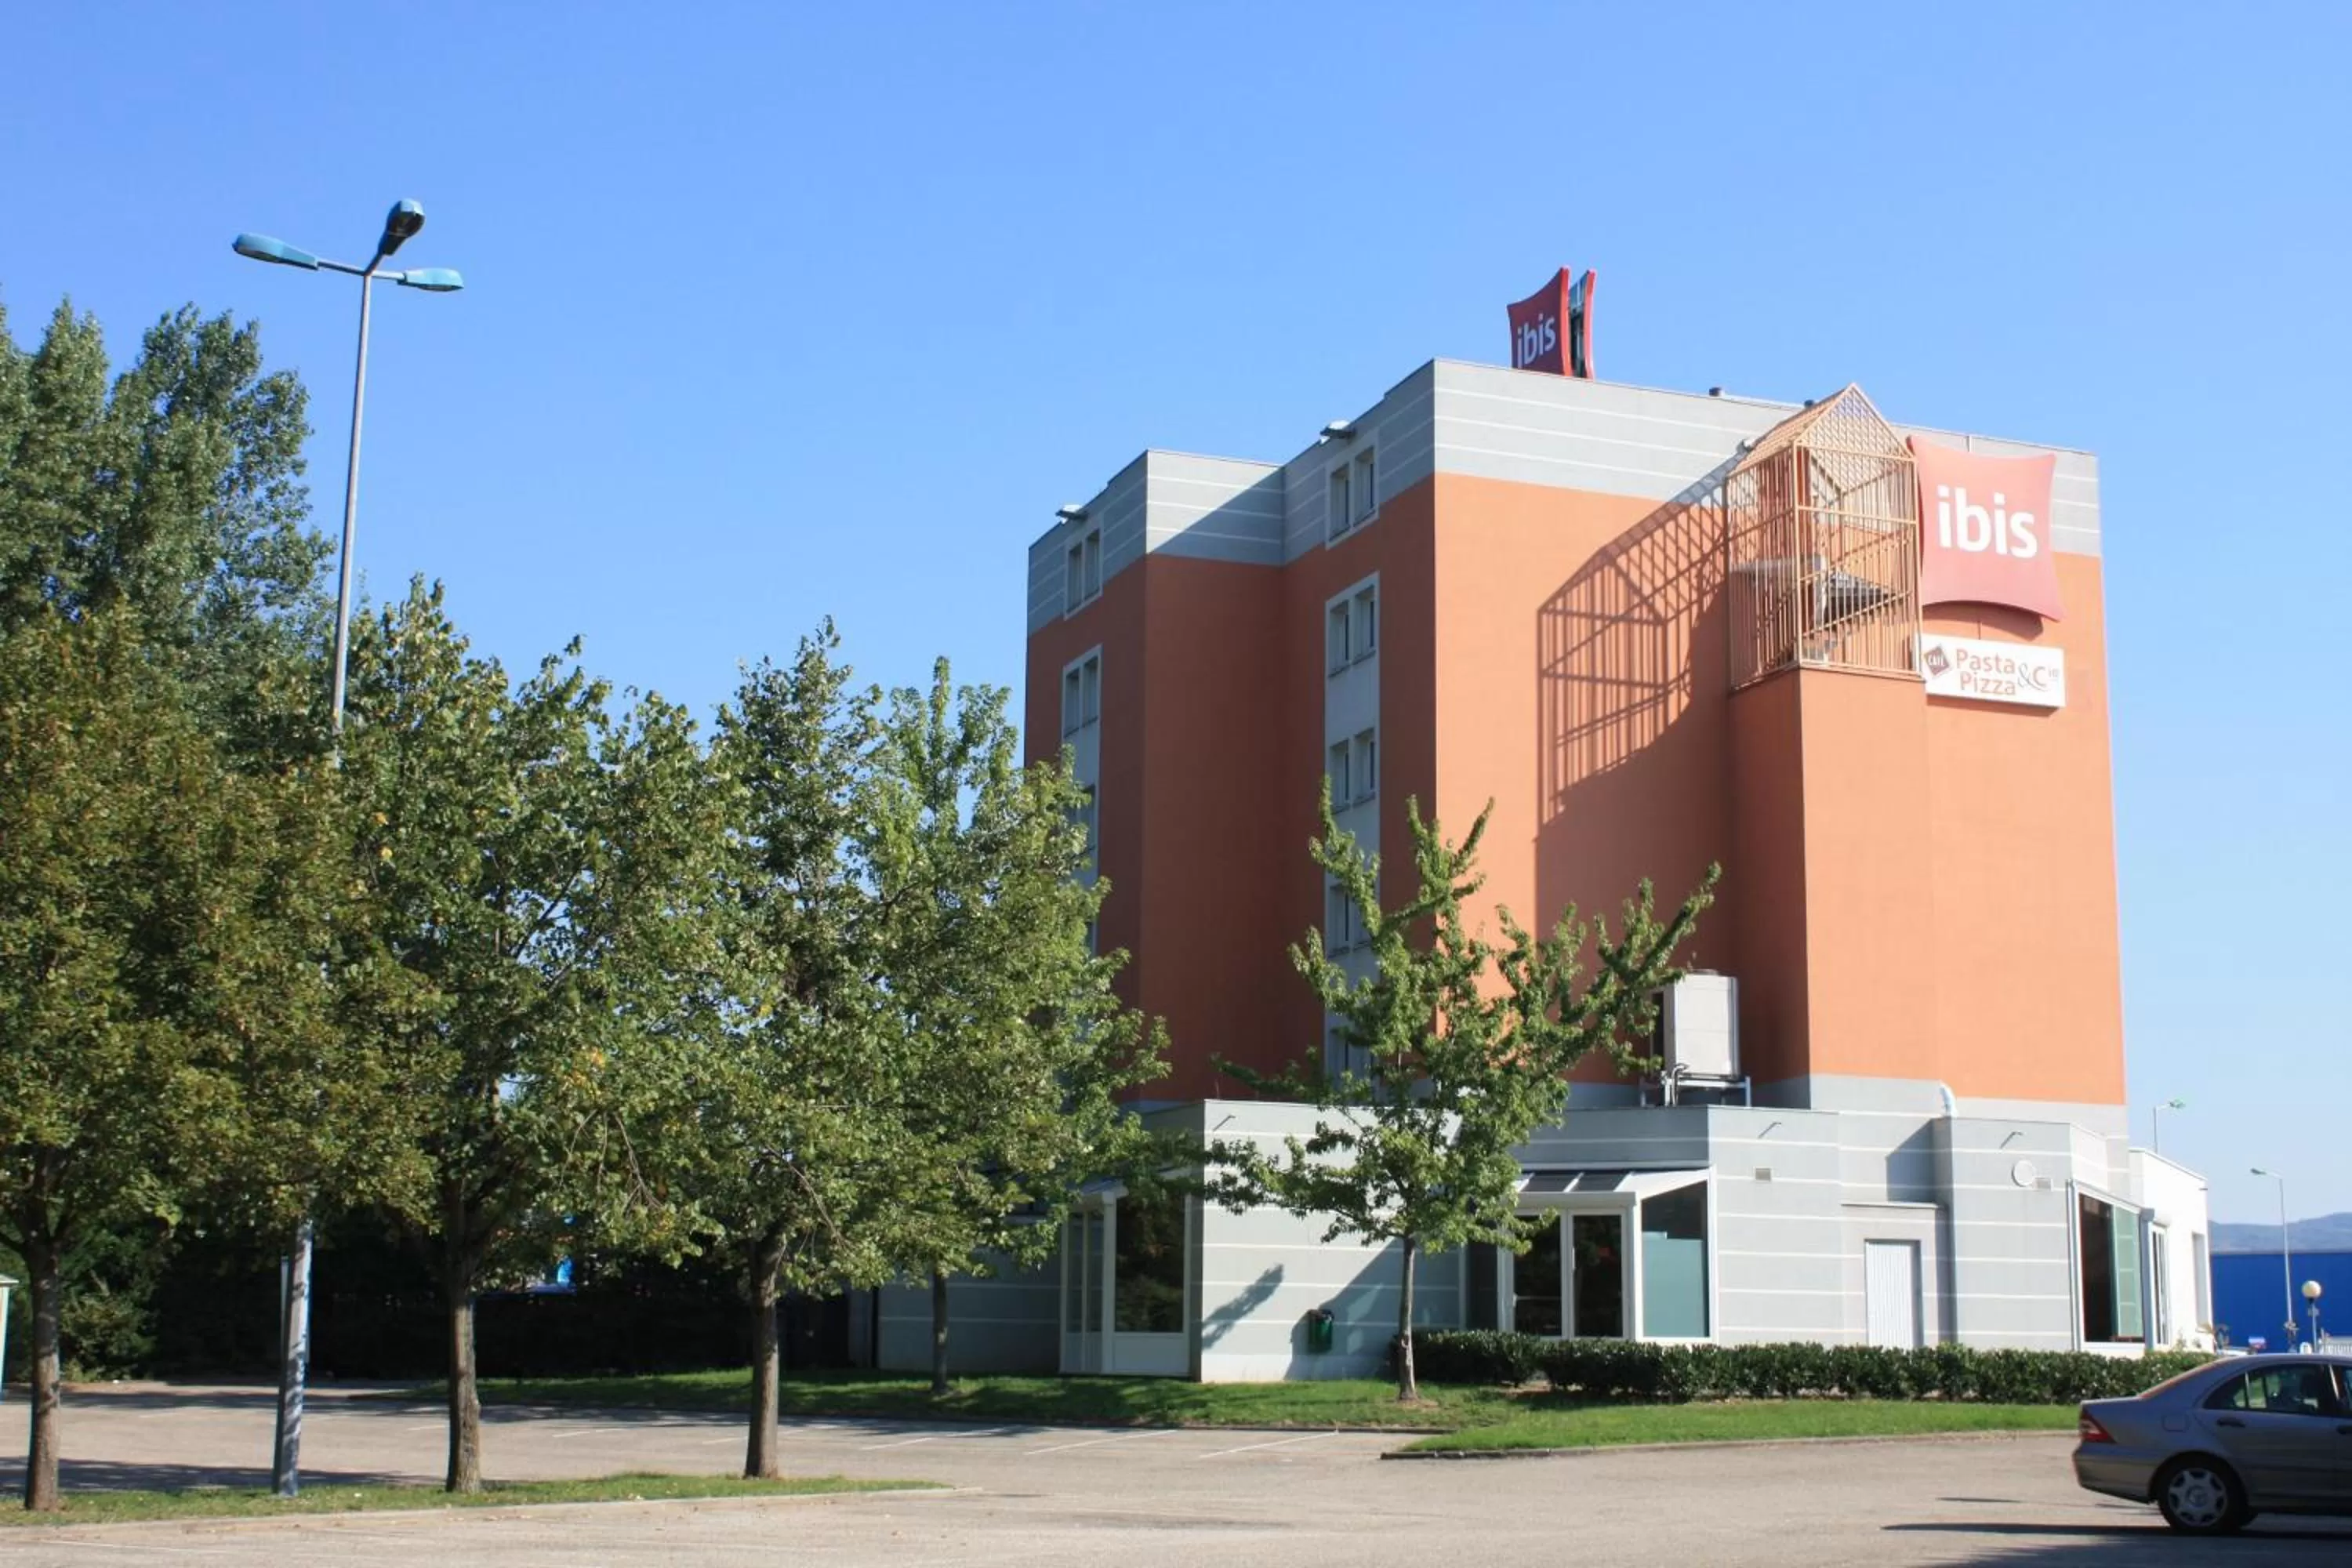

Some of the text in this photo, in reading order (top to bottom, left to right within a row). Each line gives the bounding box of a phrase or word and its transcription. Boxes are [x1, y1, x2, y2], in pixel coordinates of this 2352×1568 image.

[1517, 313, 1556, 369] ibis
[1936, 484, 2038, 559] ibis
[1956, 648, 2016, 674] Pasta
[1960, 670, 2016, 695] Pizza
